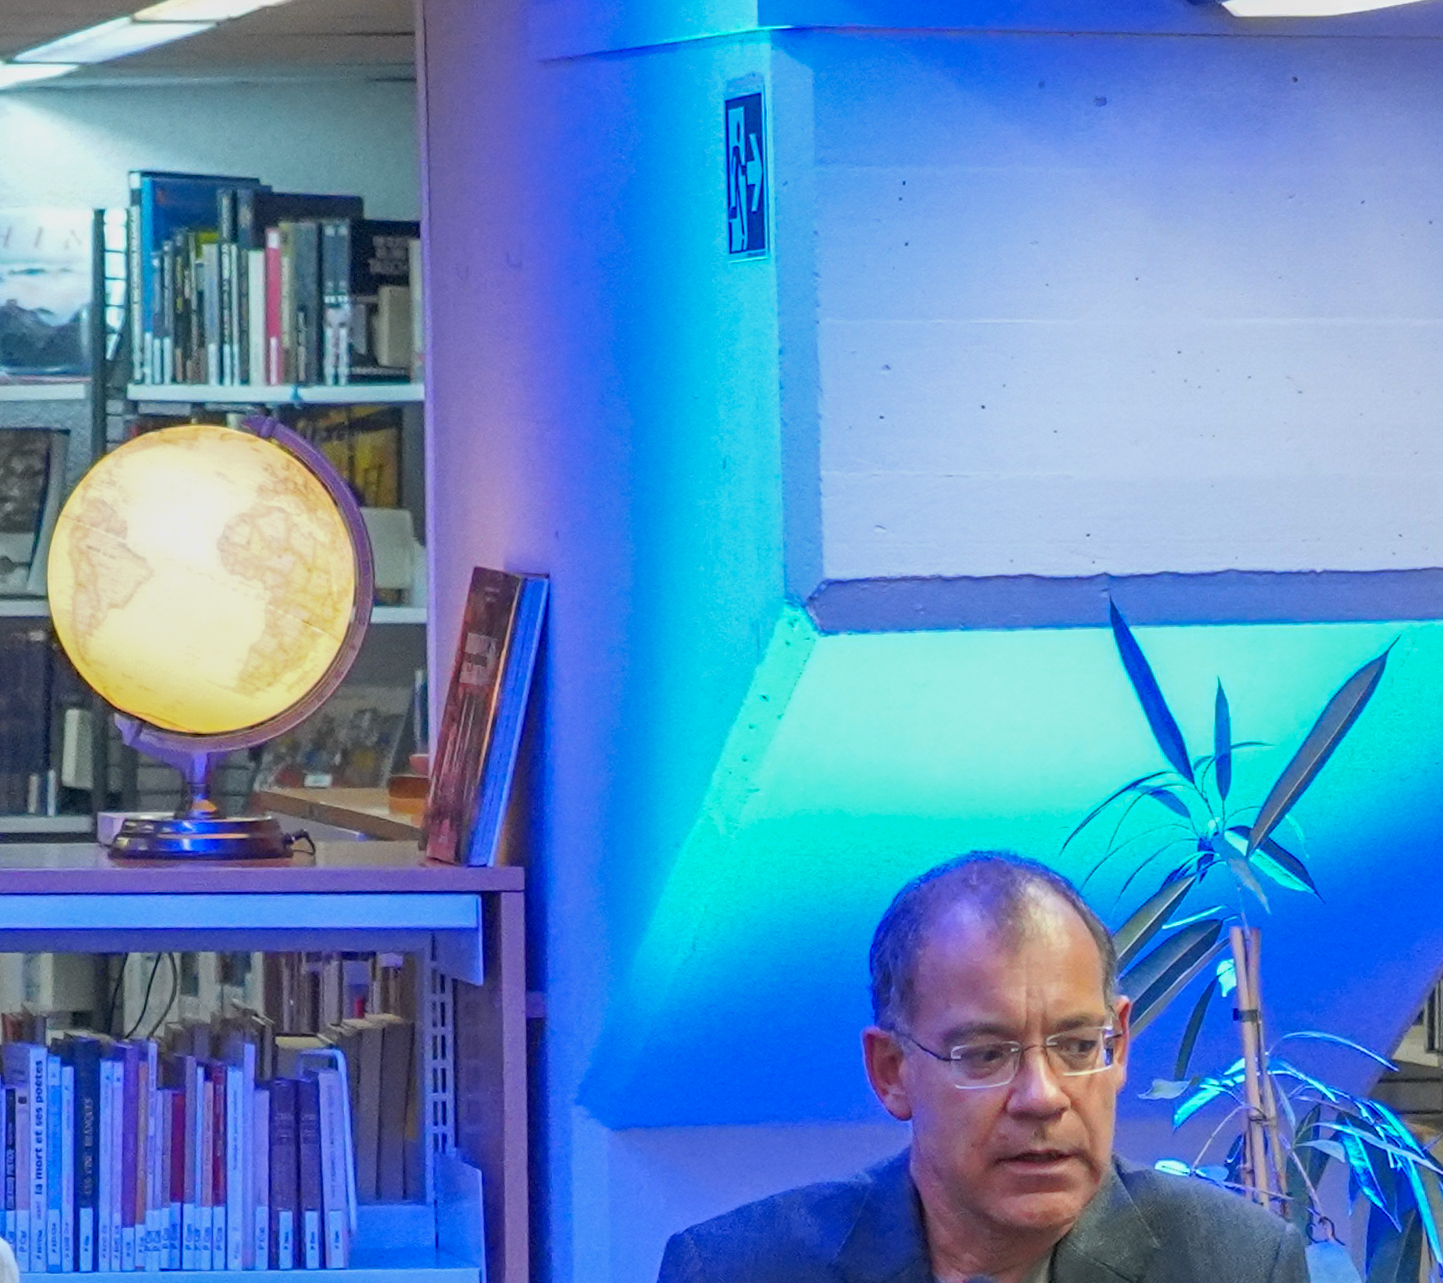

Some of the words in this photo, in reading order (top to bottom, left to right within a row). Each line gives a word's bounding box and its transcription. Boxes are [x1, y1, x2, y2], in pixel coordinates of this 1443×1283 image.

[33, 1060, 44, 1103] poètes
[35, 1107, 43, 1127] ses
[35, 1130, 43, 1144] et
[34, 1147, 43, 1179] mort
[34, 1183, 43, 1195] la
